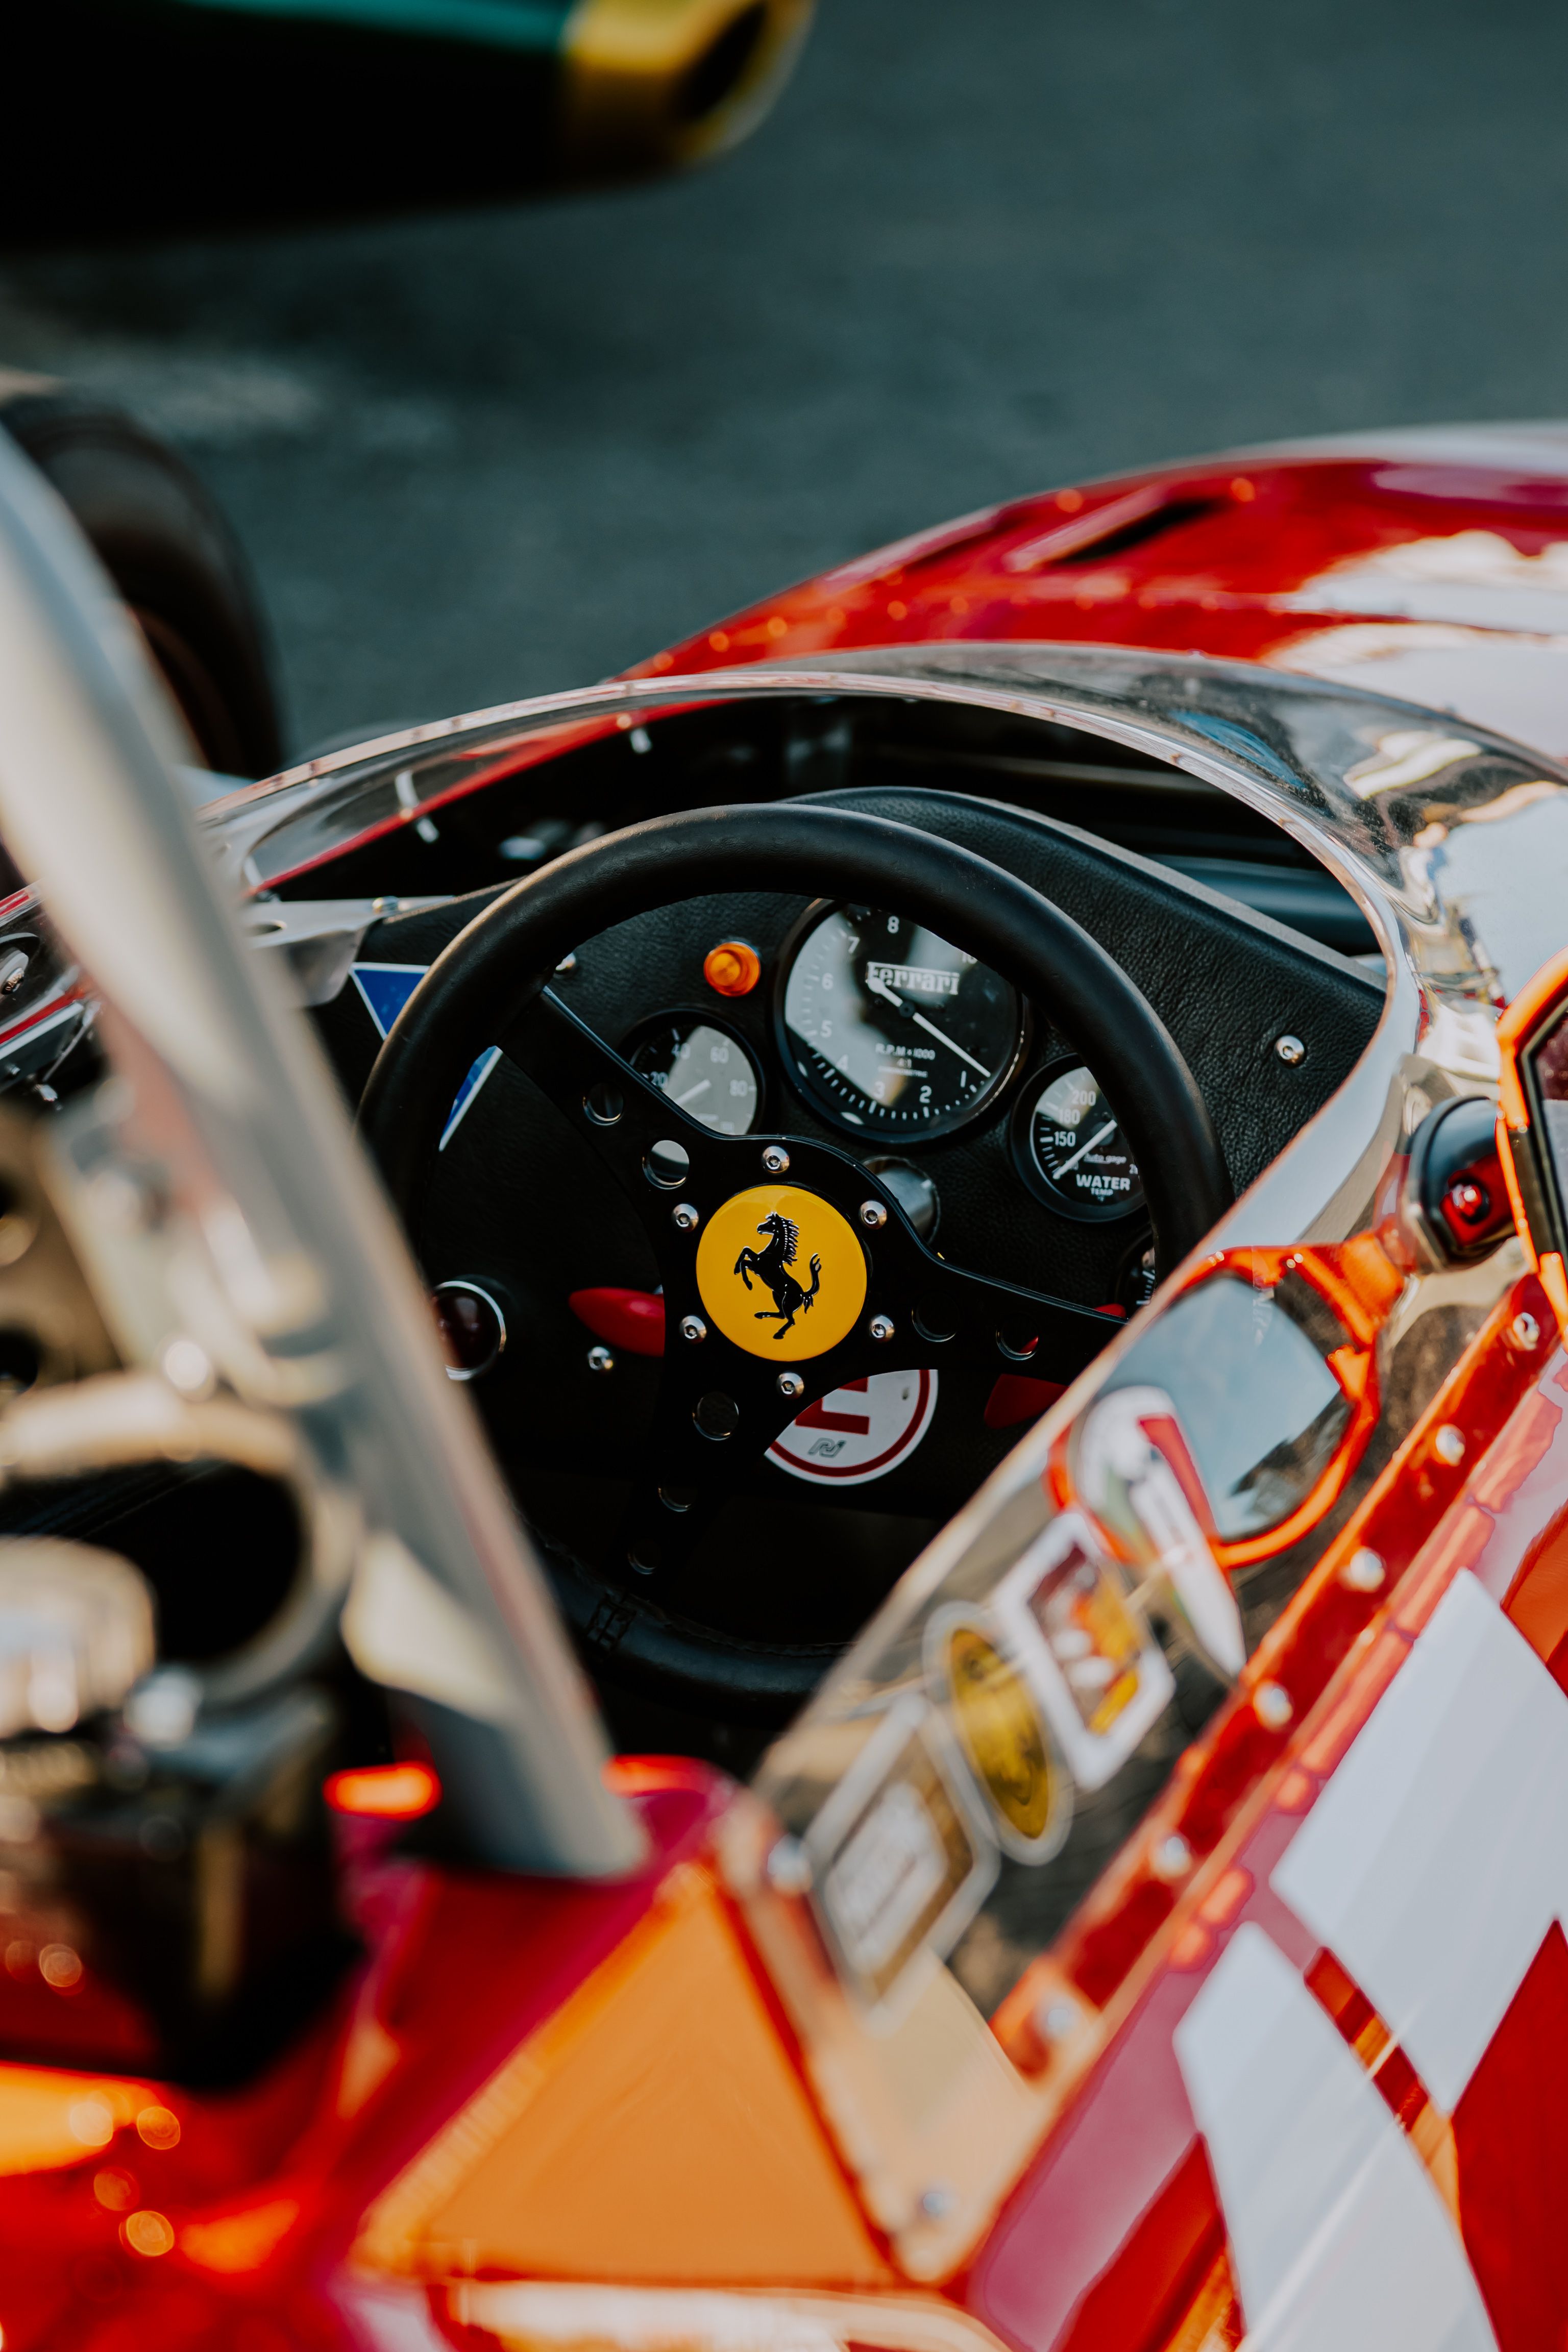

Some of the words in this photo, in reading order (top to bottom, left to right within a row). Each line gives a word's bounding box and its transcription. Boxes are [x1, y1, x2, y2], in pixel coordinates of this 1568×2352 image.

[888, 916, 899, 934] 8
[848, 936, 860, 954] 7
[822, 973, 833, 990] 6
[866, 962, 960, 995] Ferrari
[821, 1020, 832, 1038] 5
[836, 1054, 848, 1072] 4
[730, 1079, 748, 1096] 80
[960, 1070, 967, 1088] 1
[873, 1081, 885, 1099] 3
[919, 1085, 932, 1103] 2
[1071, 1089, 1096, 1107] 200
[1059, 1109, 1081, 1125] 180
[1054, 1131, 1076, 1147] 150
[1076, 1174, 1131, 1191] WATER
[1091, 1187, 1114, 1196] TEMP
